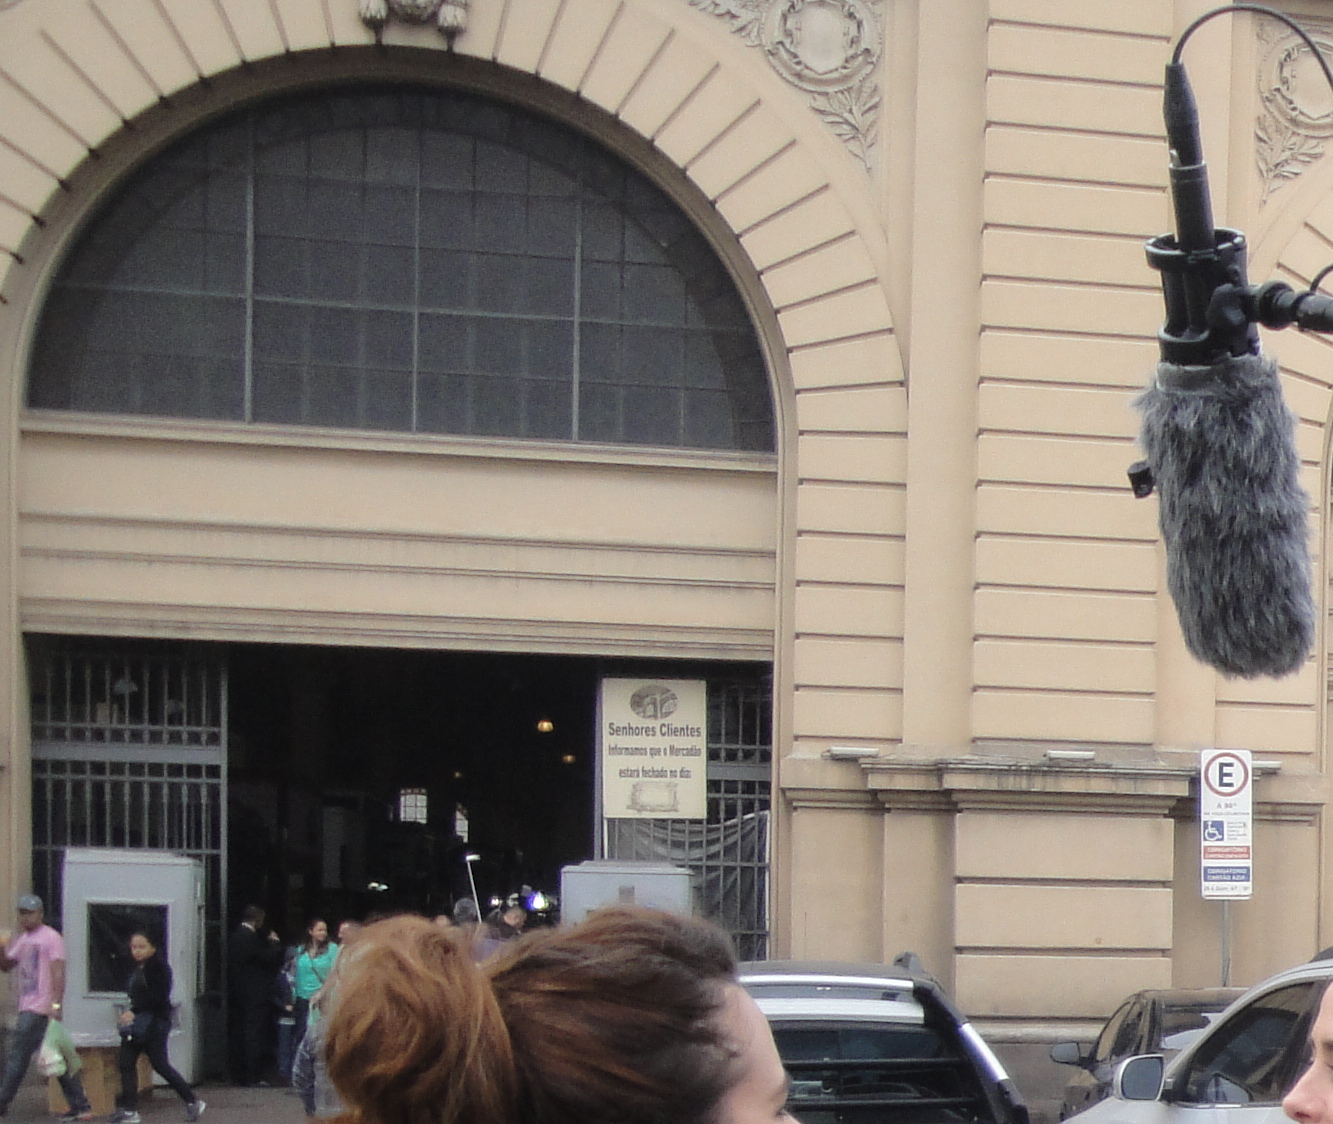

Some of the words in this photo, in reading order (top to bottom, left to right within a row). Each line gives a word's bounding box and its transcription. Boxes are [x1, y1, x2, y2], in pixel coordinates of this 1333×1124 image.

[608, 722, 657, 737] Senhores
[660, 722, 702, 737] Clientes
[608, 744, 648, 756] Informamos
[649, 747, 662, 759] que
[1218, 762, 1235, 788] E
